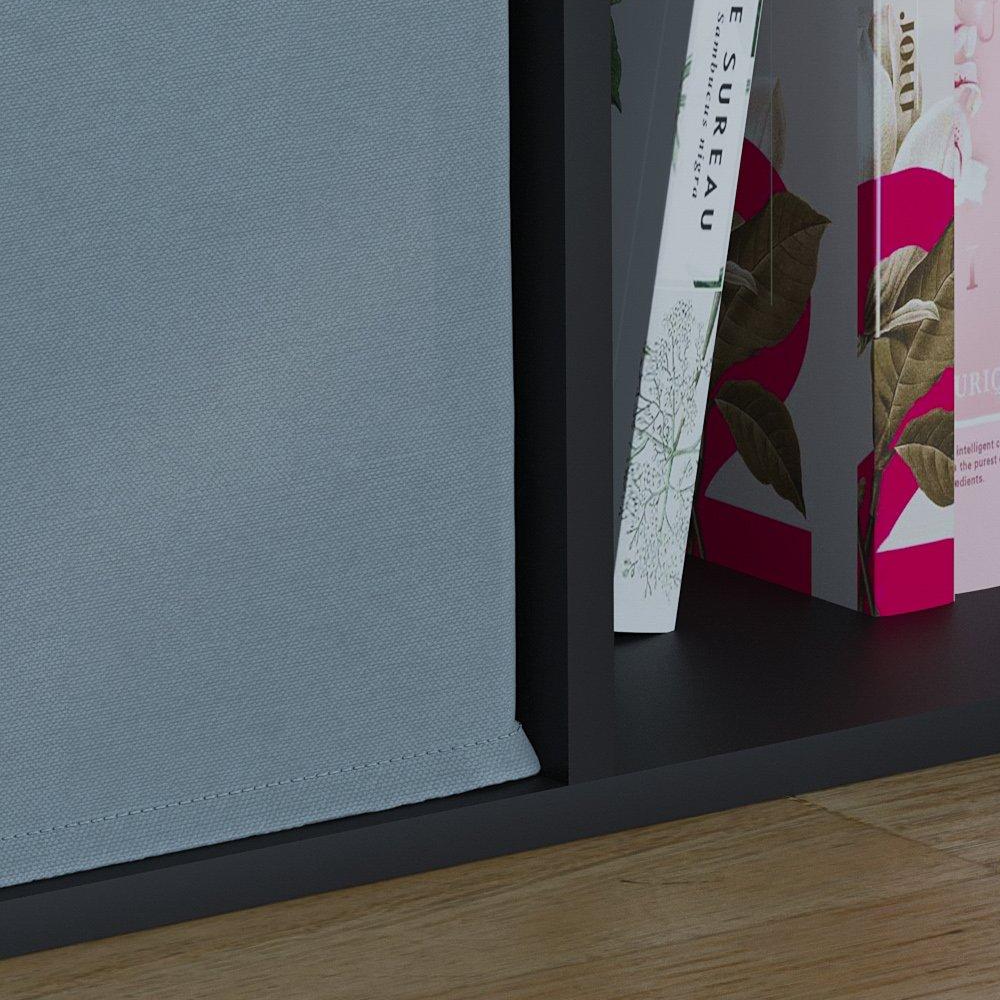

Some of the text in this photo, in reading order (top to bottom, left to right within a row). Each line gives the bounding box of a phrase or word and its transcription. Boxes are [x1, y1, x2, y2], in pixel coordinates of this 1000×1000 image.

[691, 11, 725, 199] Sambucus nigra
[700, 52, 737, 232] SUREAU
[956, 439, 994, 455] intelligent
[959, 461, 972, 472] the
[974, 455, 997, 471] purest
